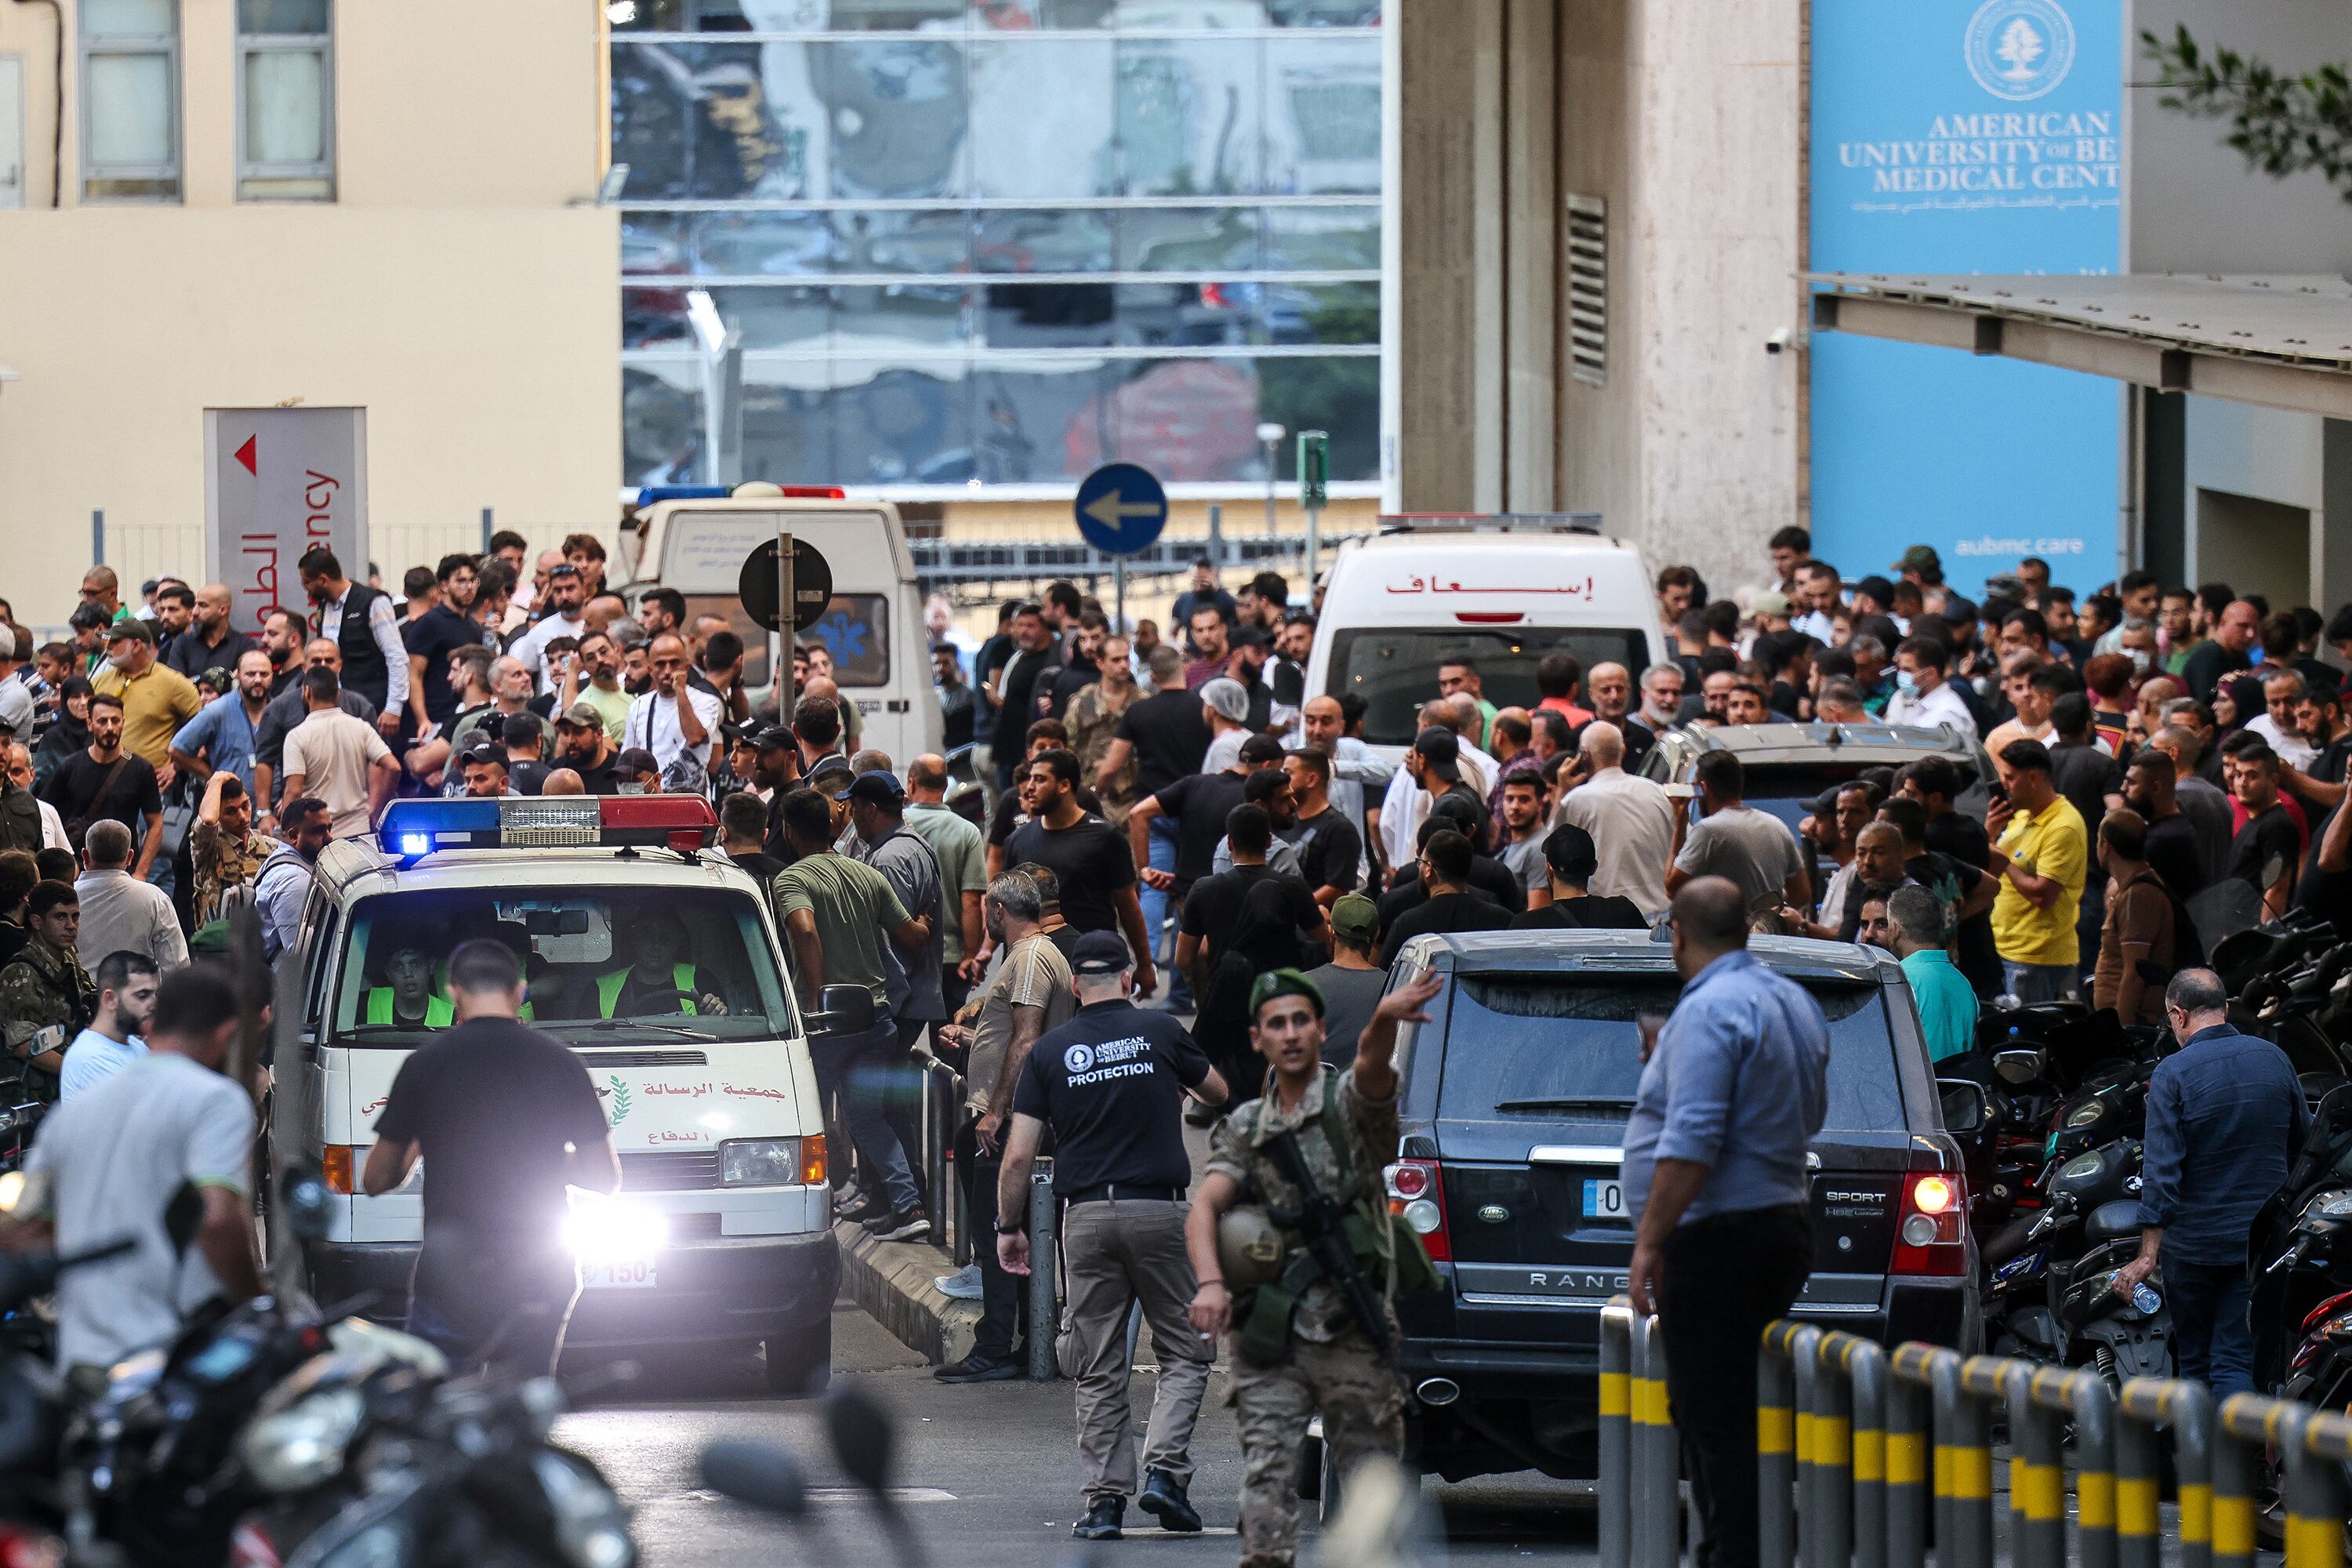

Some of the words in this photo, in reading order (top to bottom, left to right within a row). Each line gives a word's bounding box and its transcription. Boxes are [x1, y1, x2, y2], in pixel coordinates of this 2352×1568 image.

[1929, 111, 2111, 139] AMERICAN
[1839, 139, 2045, 168] UNIVERSITY
[1874, 165, 2025, 192] MEDICAL
[1385, 573, 1593, 602] إسعاف
[1095, 1036, 1145, 1051] AMERICAN
[1095, 1044, 1151, 1058] UNIVERSITY
[1105, 1051, 1138, 1063] BEIRUT
[1067, 1062, 1154, 1088] PROTECTION
[643, 1082, 713, 1098] الرسالة
[721, 1082, 786, 1103] جمعية
[648, 1130, 710, 1145] الدفاع
[1826, 1192, 1886, 1202] SPORT
